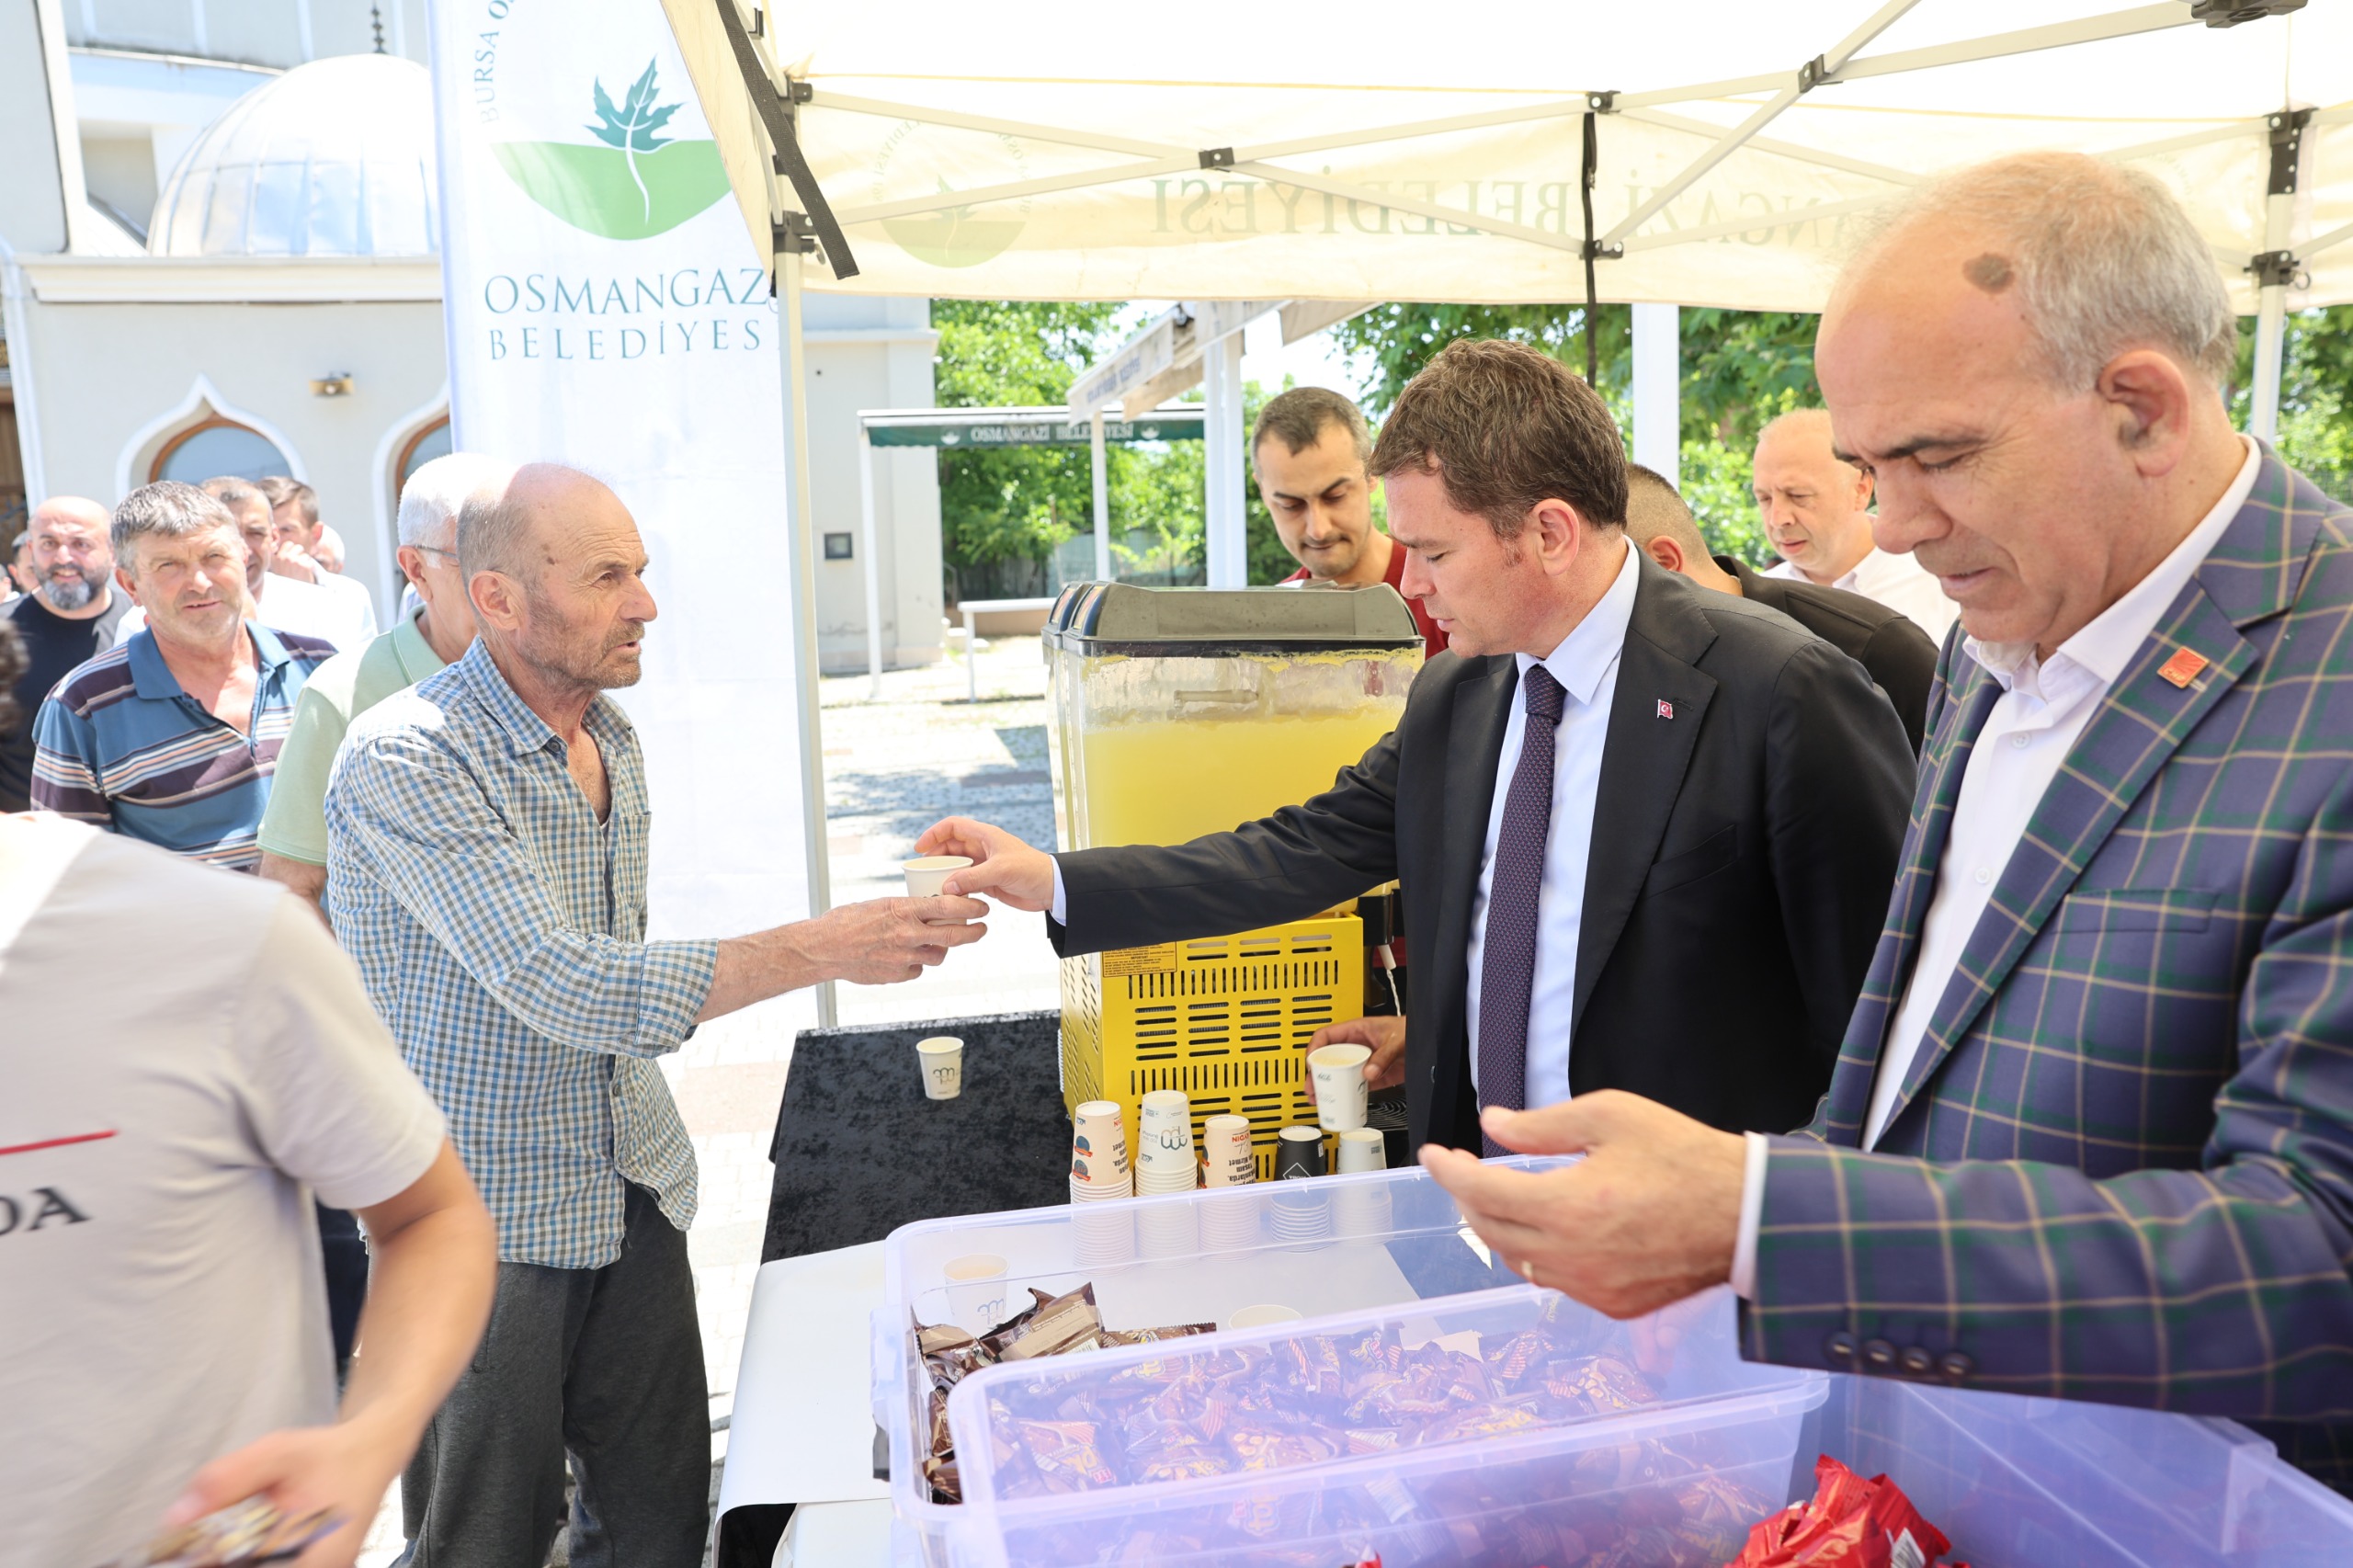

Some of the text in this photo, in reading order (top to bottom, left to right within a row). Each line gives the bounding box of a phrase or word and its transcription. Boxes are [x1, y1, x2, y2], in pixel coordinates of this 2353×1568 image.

[473, 30, 501, 124] BURSA
[484, 267, 768, 315] OSMANGAZ
[490, 319, 761, 360] BELEDİYES
[1056, 422, 1134, 441] BELEYESİ
